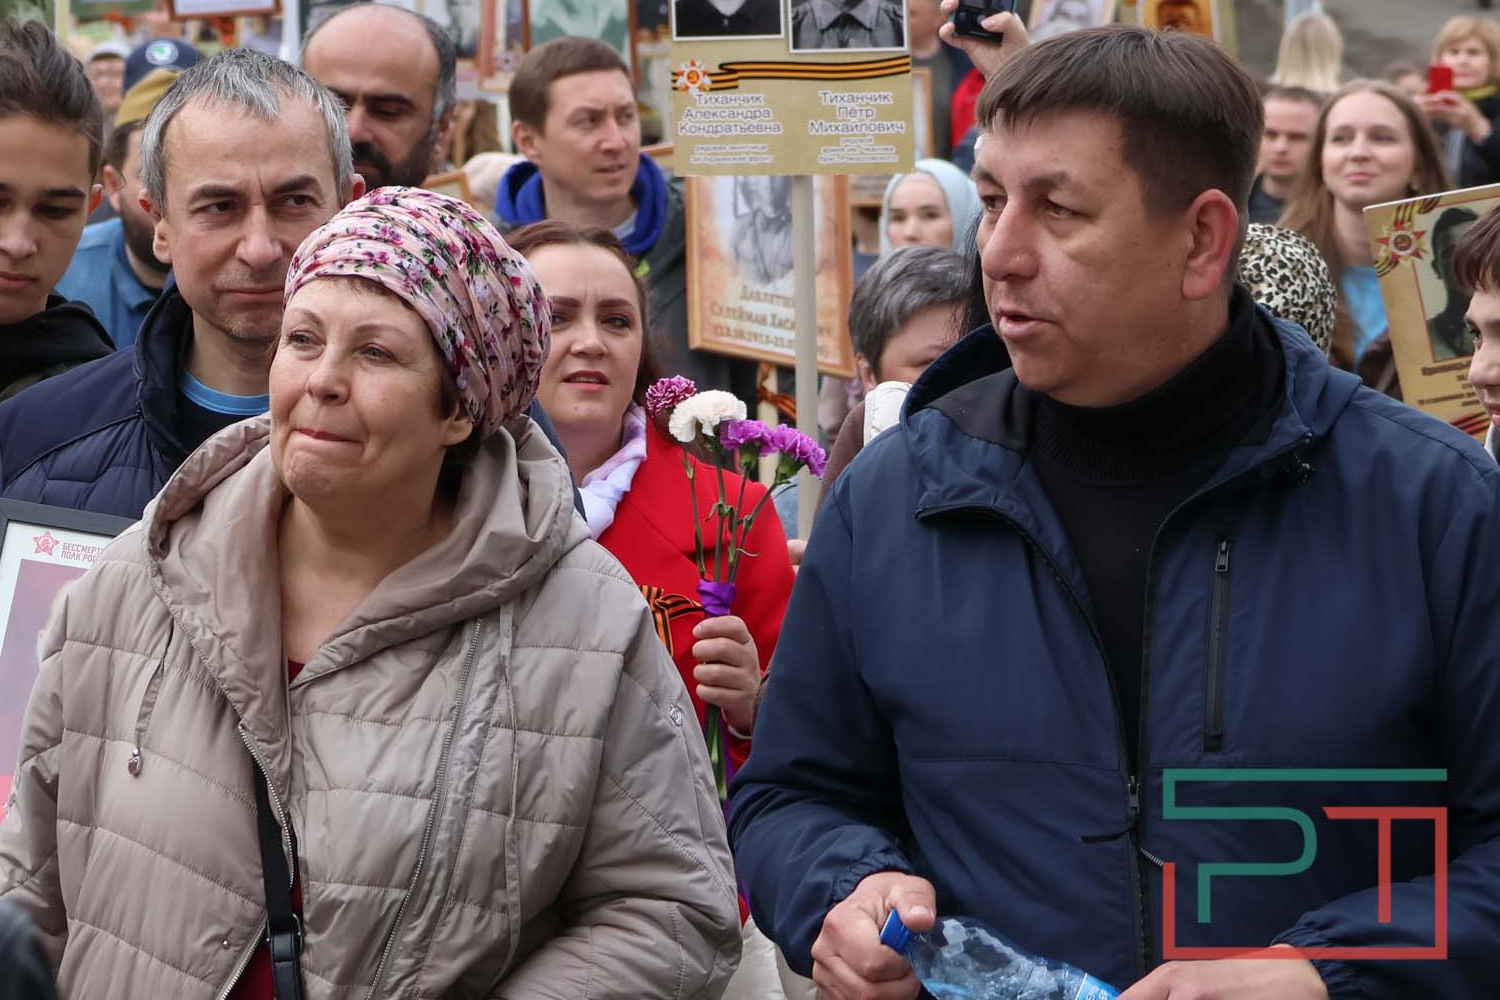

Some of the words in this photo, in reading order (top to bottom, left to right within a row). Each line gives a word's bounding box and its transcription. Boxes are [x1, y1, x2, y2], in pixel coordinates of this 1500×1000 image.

[695, 94, 763, 105] Тиханчик
[820, 92, 892, 104] Тиханчик
[684, 107, 771, 120] Александра
[838, 106, 875, 119] Пётр
[679, 121, 781, 136] Кондратьевна
[810, 121, 905, 134] Михайлович
[61, 550, 81, 561] ПОЛК
